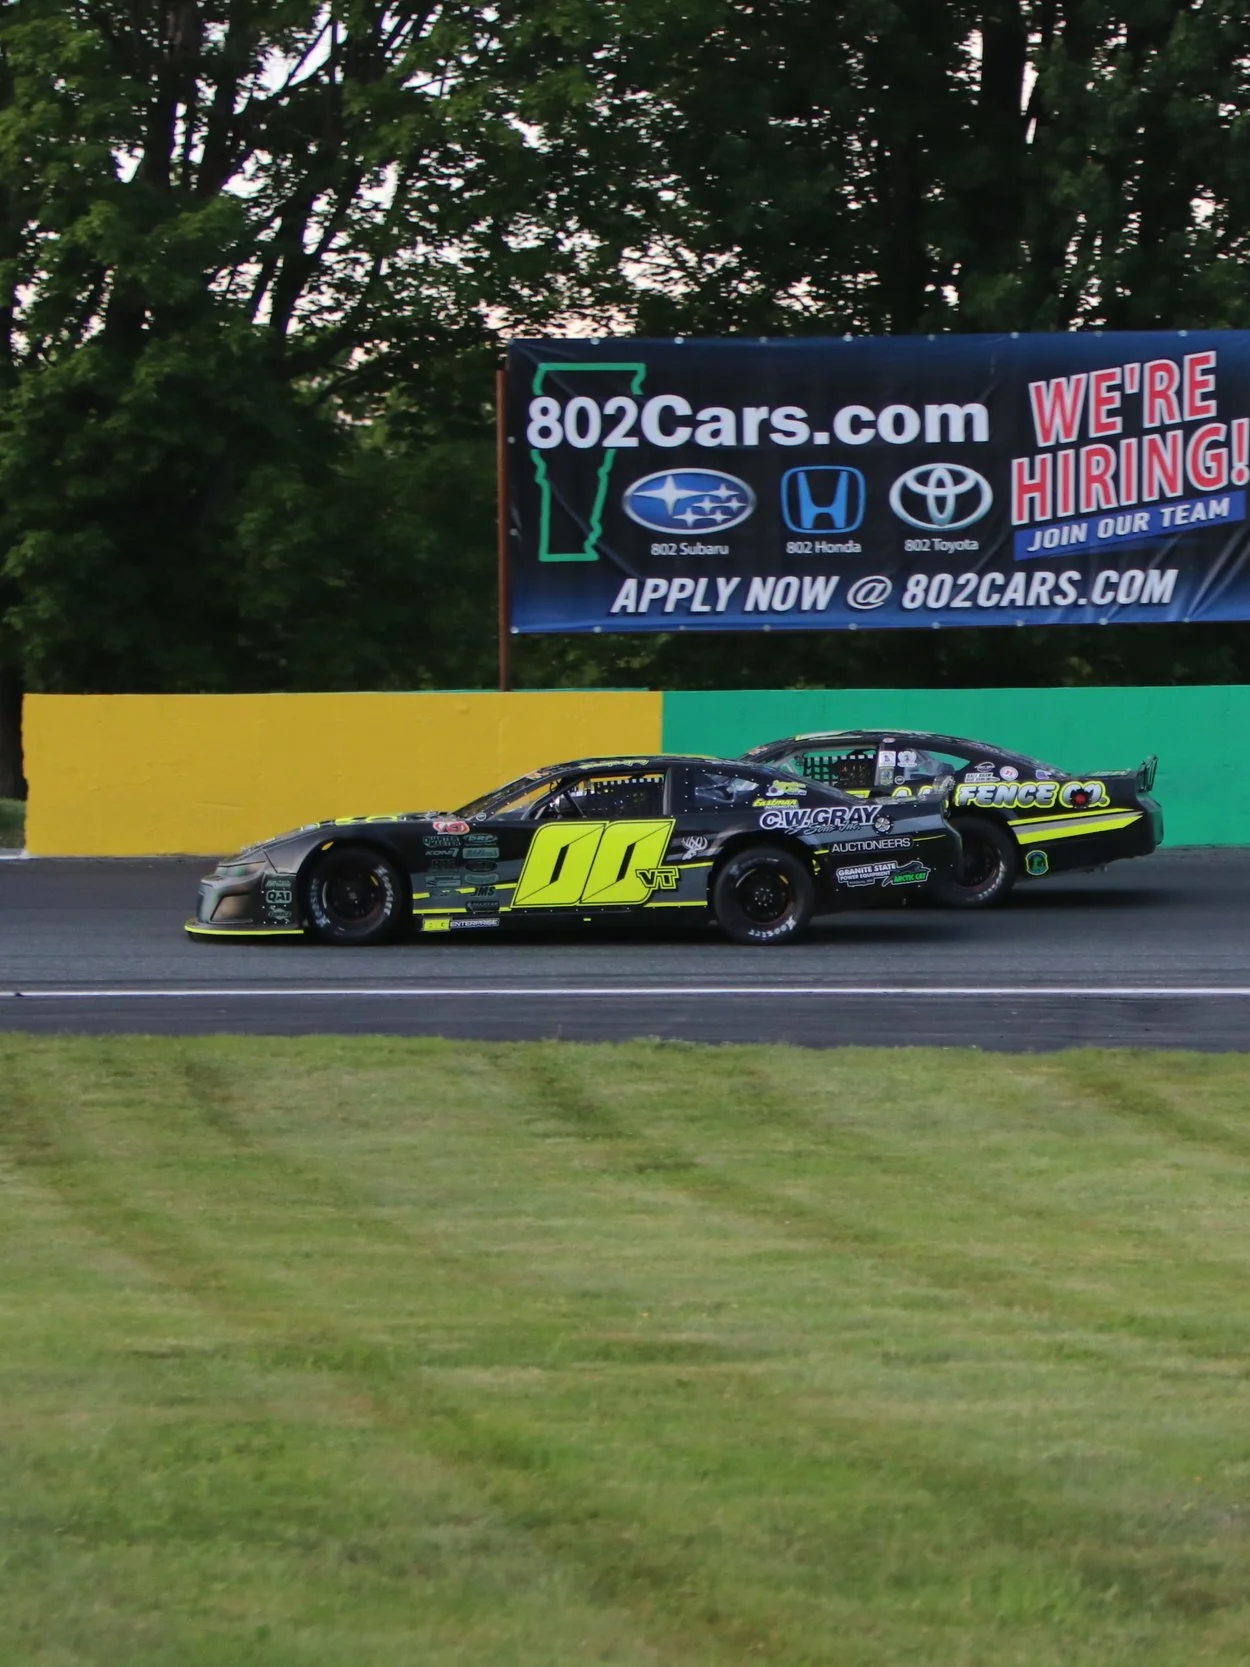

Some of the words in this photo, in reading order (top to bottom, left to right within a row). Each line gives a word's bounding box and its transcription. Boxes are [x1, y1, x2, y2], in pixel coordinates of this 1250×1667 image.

[1028, 350, 1218, 447] WE'RE
[526, 393, 991, 450] 802Cars.com
[1026, 523, 1088, 553] JOIN
[1097, 512, 1151, 537] OUR
[1159, 497, 1231, 529] TEAM
[650, 543, 677, 556] 802
[679, 542, 730, 557] Subaru
[786, 542, 812, 555] 802
[814, 541, 862, 555] Honda
[904, 539, 930, 553] 802
[931, 538, 980, 554] Toyota
[610, 576, 740, 615] APPLY
[745, 575, 839, 612] NOW
[847, 575, 894, 610] @
[900, 569, 1180, 611] 802CARS.COM
[955, 781, 1060, 808] FENCE
[831, 837, 911, 854] AUCTIONEERS
[510, 818, 677, 908] 00
[838, 866, 873, 876] GRANITE
[874, 863, 897, 872] STATE
[636, 865, 679, 890] VT
